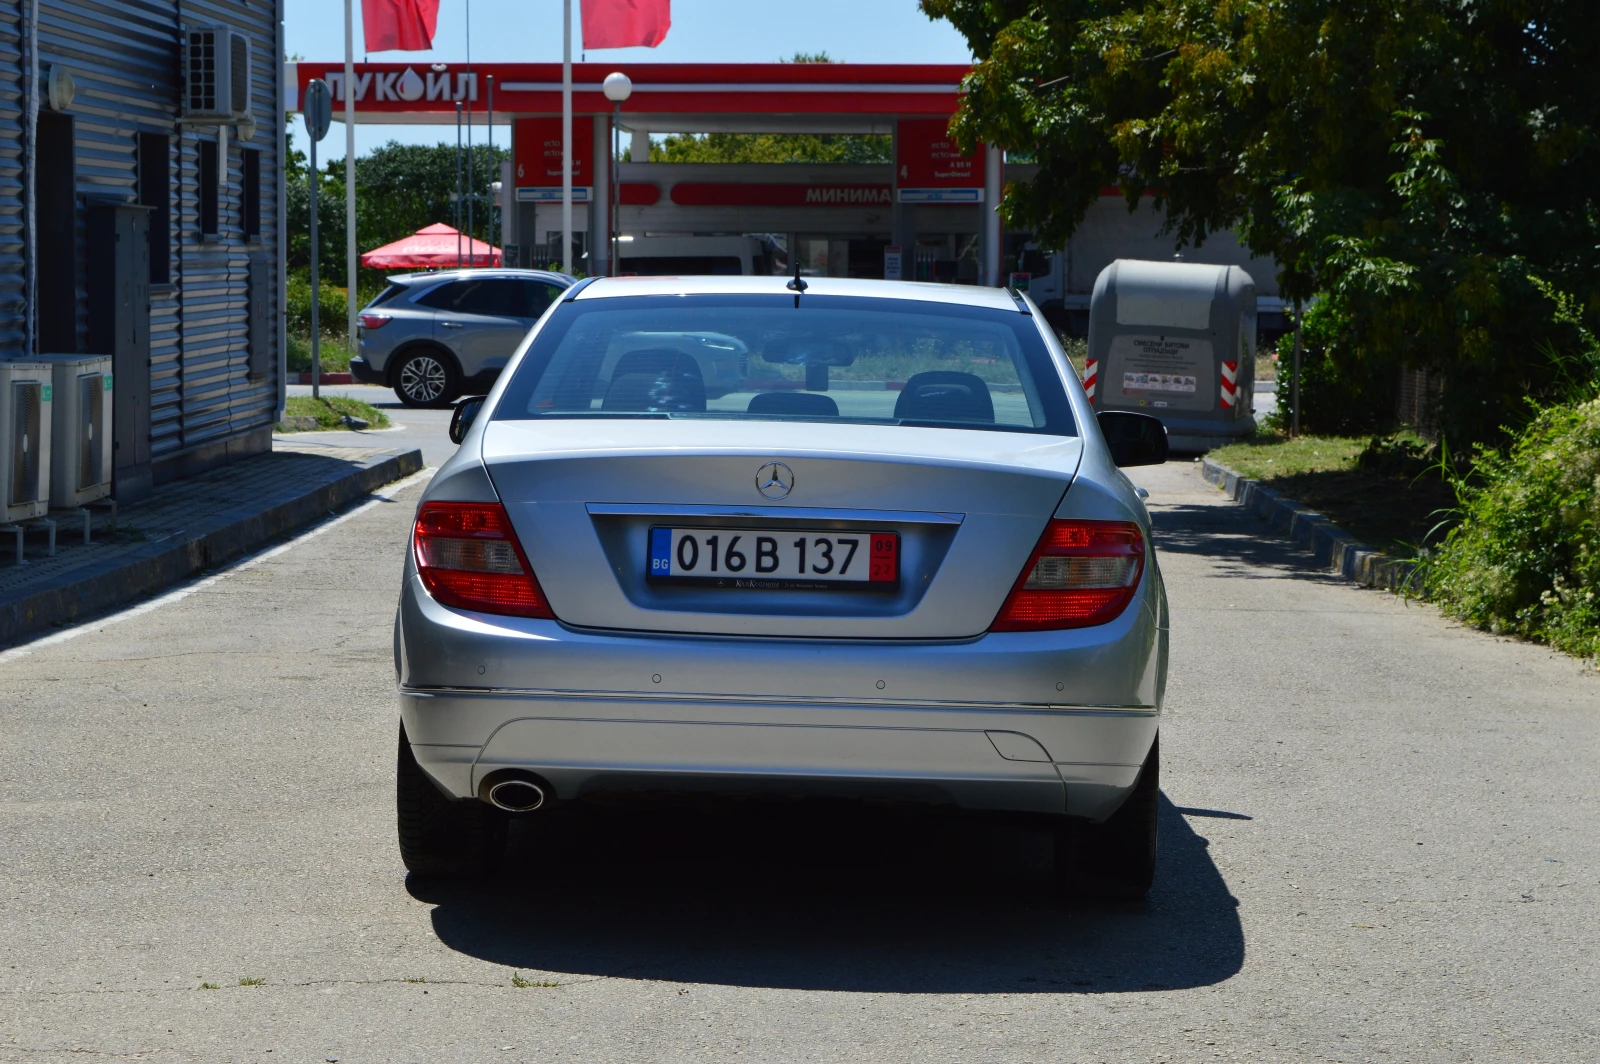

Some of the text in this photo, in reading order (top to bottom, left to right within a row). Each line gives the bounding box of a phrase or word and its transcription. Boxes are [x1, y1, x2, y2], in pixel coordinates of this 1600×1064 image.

[518, 164, 525, 178] 6
[901, 165, 908, 179] 4
[806, 188, 892, 202] МИНИМА
[875, 540, 893, 552] 09
[653, 558, 669, 570] BG
